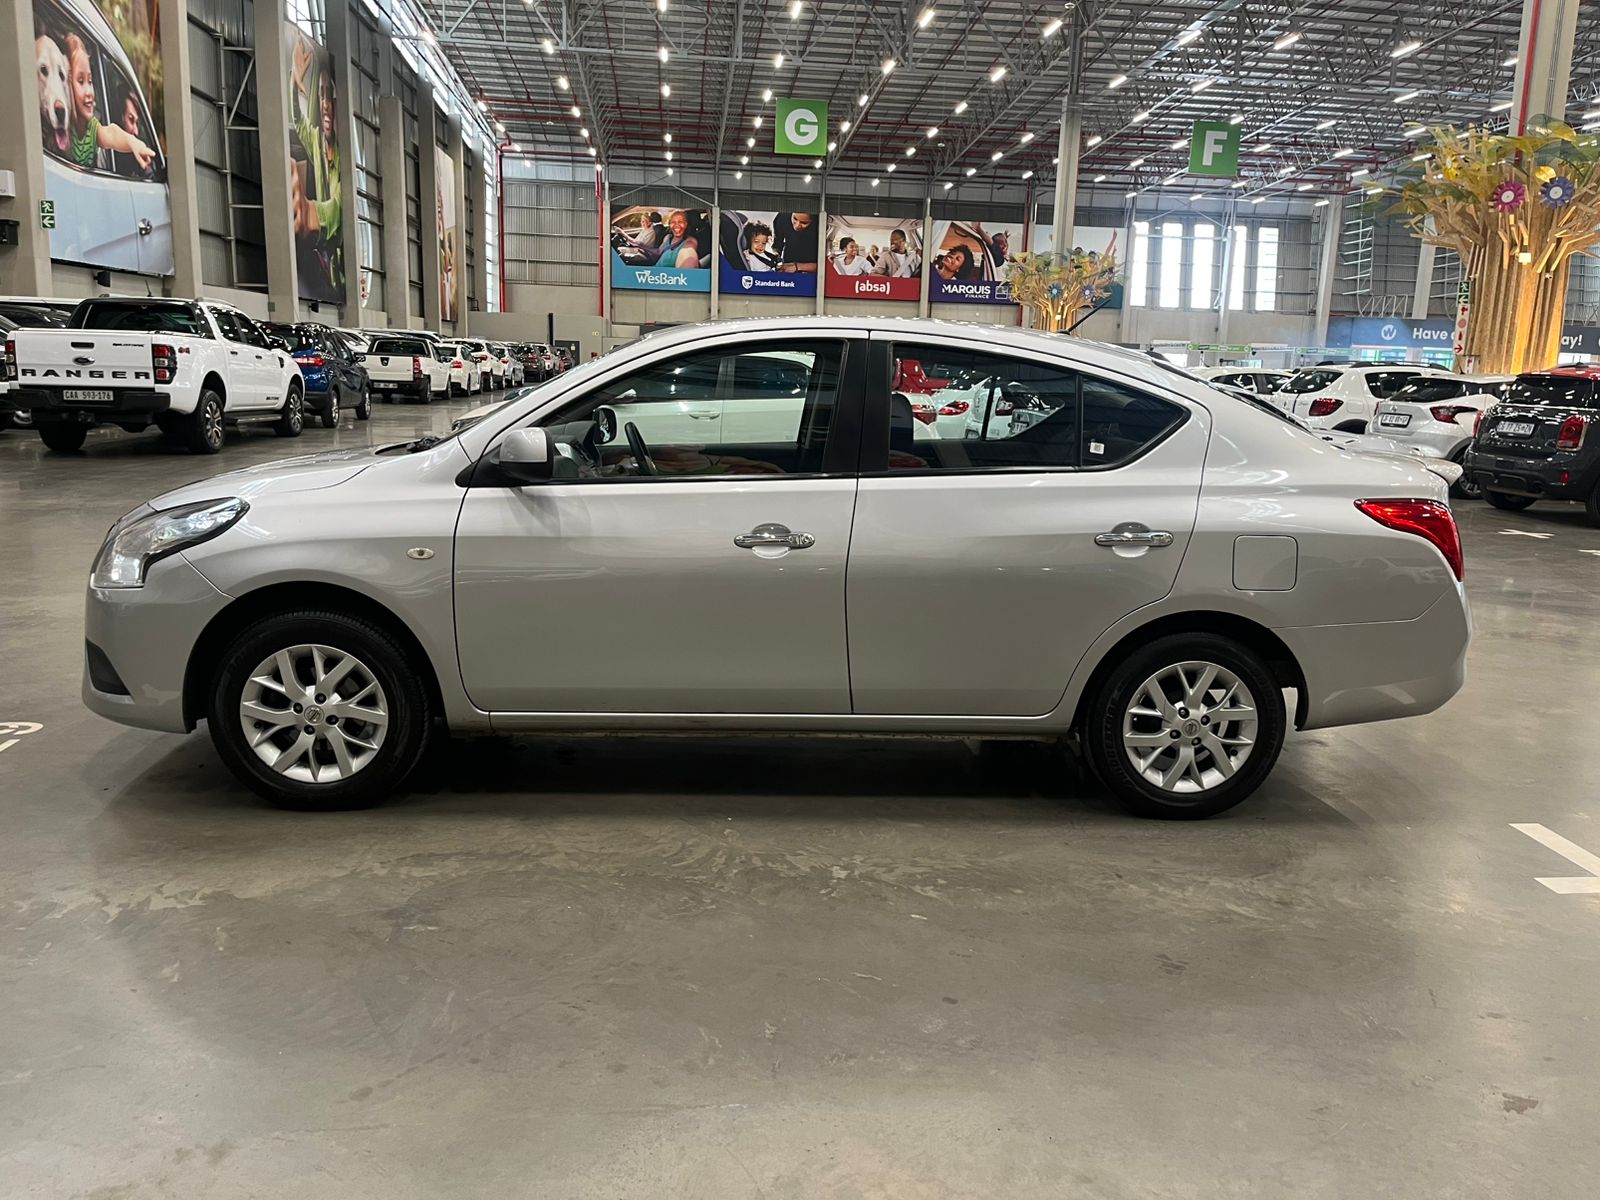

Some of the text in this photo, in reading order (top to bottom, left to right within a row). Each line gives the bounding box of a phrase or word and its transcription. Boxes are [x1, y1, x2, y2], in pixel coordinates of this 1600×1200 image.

[784, 108, 819, 146] G
[1202, 130, 1228, 166] F
[635, 270, 688, 286] WesBank
[754, 279, 795, 288] Standard Bank
[855, 280, 891, 295] (absa)
[941, 283, 991, 295] MARQUIS
[1412, 327, 1583, 350] Have ay!
[21, 368, 151, 380] RANGER
[64, 391, 112, 400] CAA 593-176
